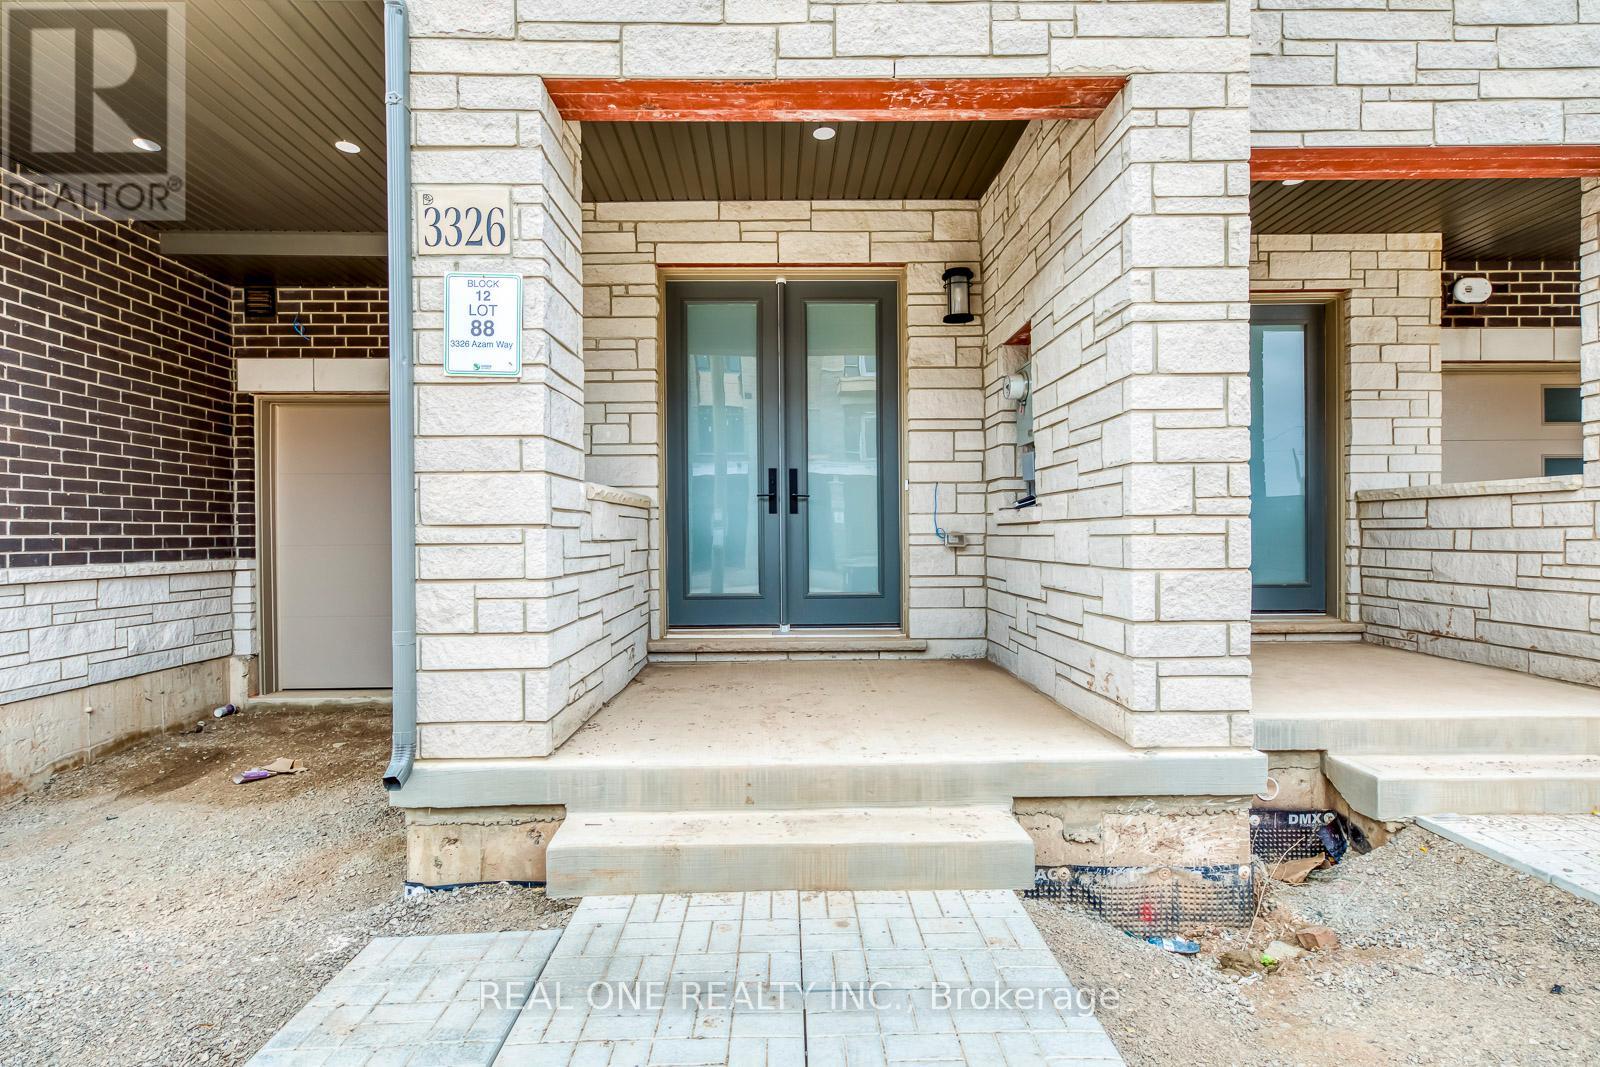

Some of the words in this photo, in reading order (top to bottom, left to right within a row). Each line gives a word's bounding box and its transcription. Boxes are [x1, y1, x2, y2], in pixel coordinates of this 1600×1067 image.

[424, 206, 506, 247] 3326
[467, 279, 500, 288] BLOCK
[475, 290, 491, 301] 12
[469, 304, 498, 316] LOT
[470, 320, 495, 337] 88
[450, 340, 470, 348] 3326
[471, 340, 494, 348] Azam
[496, 341, 514, 350] Way
[1288, 813, 1321, 825] DMX
